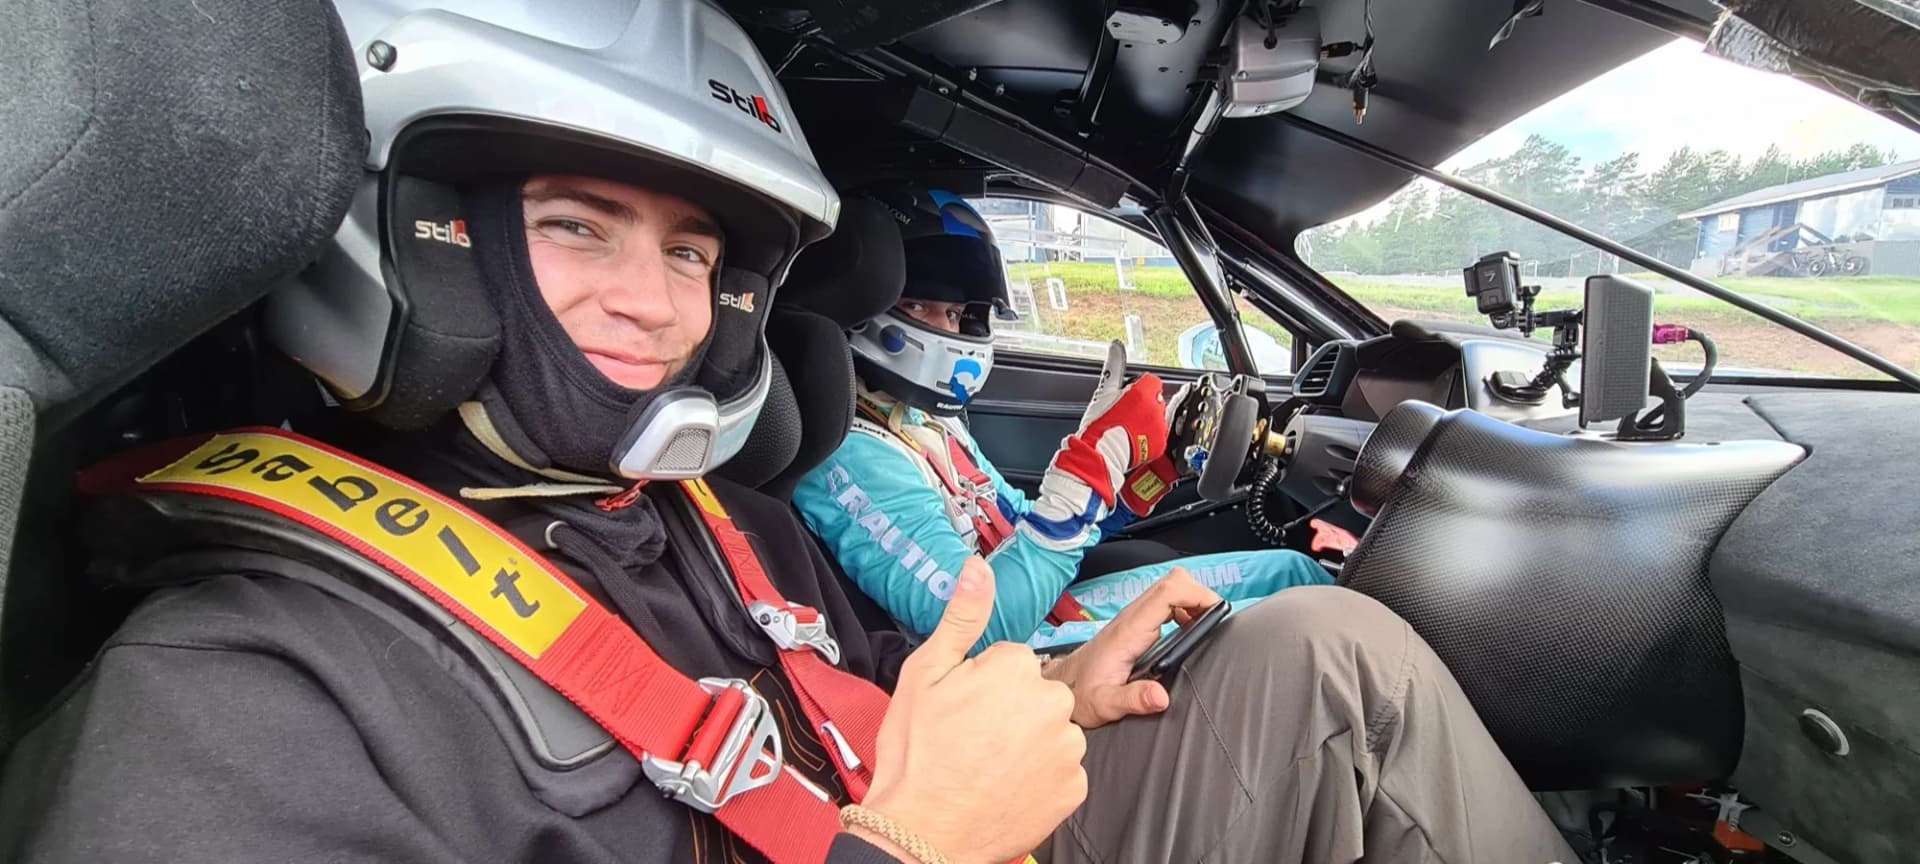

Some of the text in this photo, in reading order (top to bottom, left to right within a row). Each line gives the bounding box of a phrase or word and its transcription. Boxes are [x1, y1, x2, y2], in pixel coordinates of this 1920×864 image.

[708, 79, 781, 133] Stilo
[415, 219, 471, 248] Stilo
[719, 291, 754, 313] Stilo
